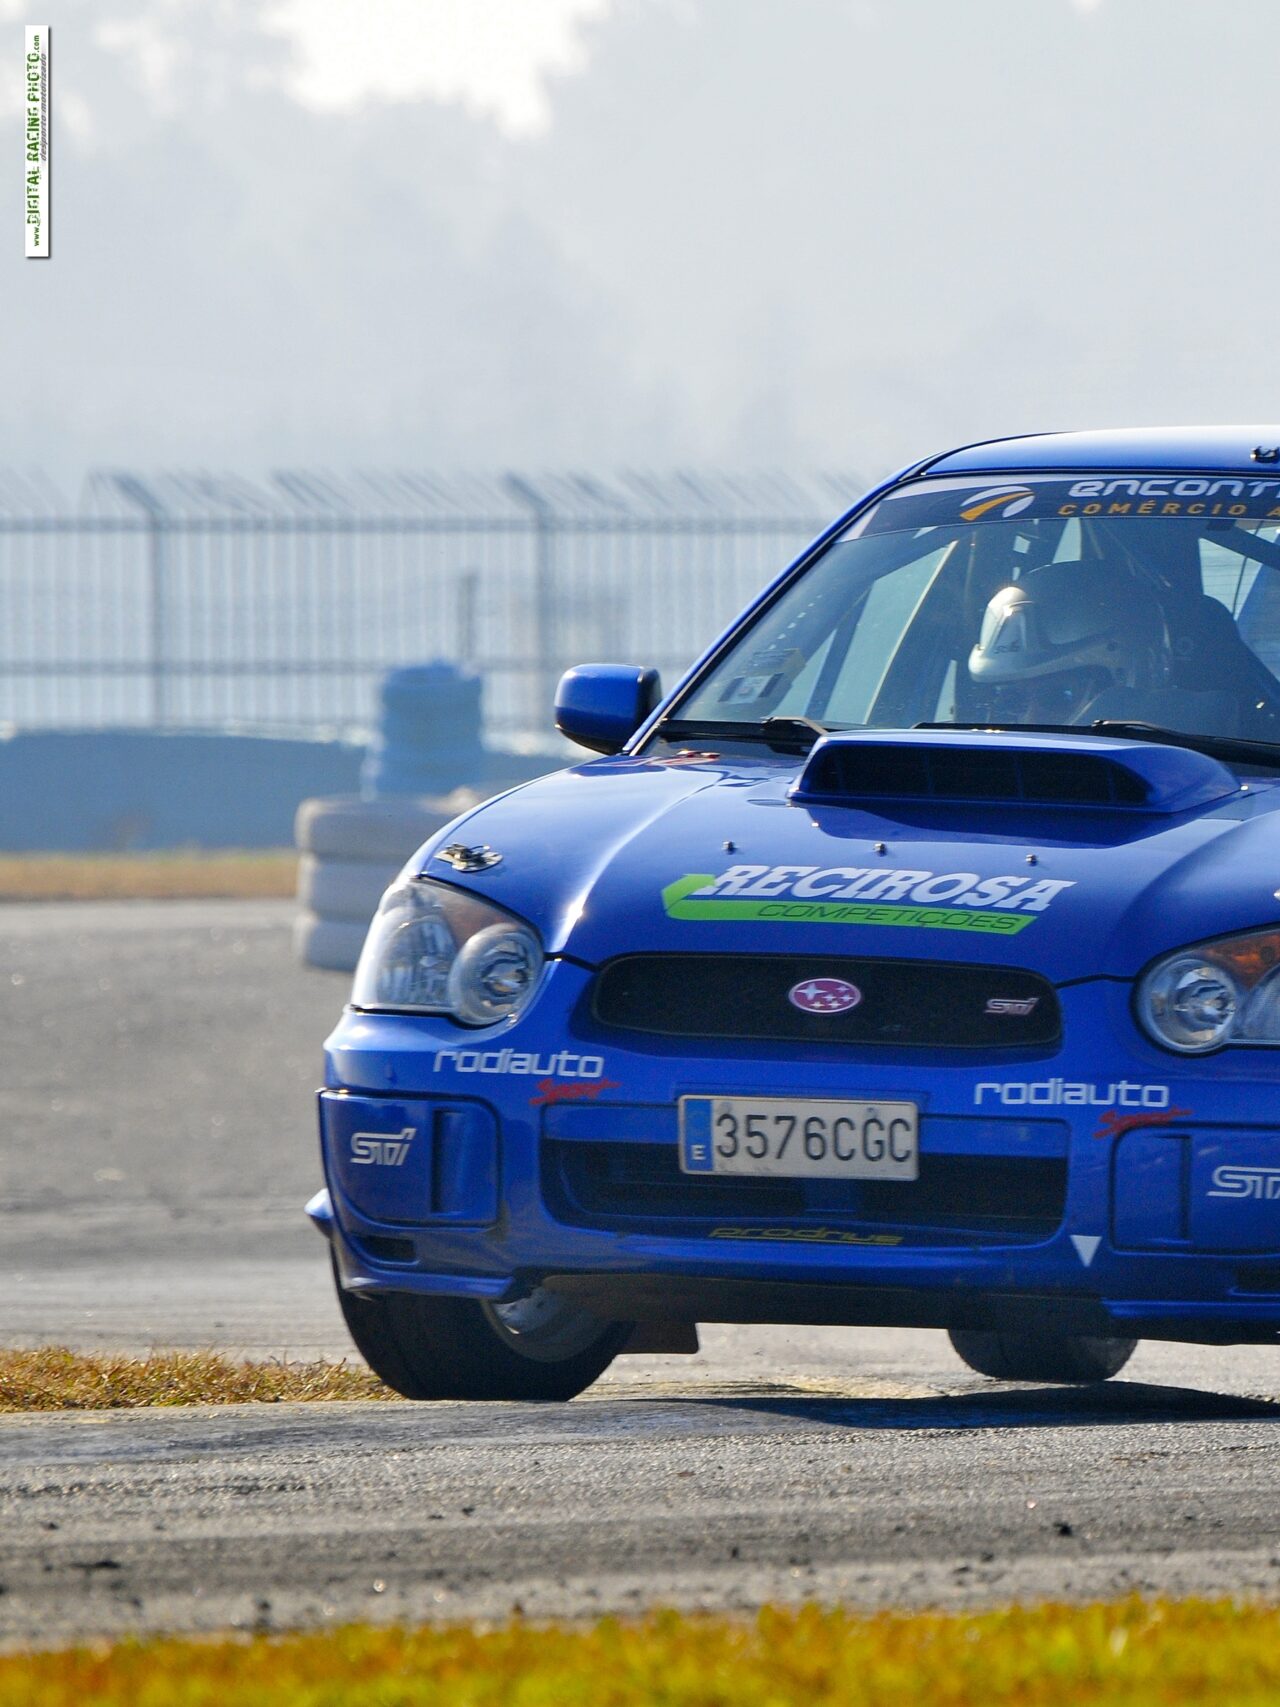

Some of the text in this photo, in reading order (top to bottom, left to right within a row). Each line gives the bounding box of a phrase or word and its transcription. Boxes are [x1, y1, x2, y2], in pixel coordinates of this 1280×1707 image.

[1057, 500, 1246, 516] COMÉRCIO
[694, 865, 1078, 911] RECIROSA
[757, 904, 1022, 930] COMPETIÇÕES
[433, 1048, 605, 1078] rodiauto
[973, 1078, 1169, 1108] rodiauto
[715, 1113, 912, 1163] 3576CGC
